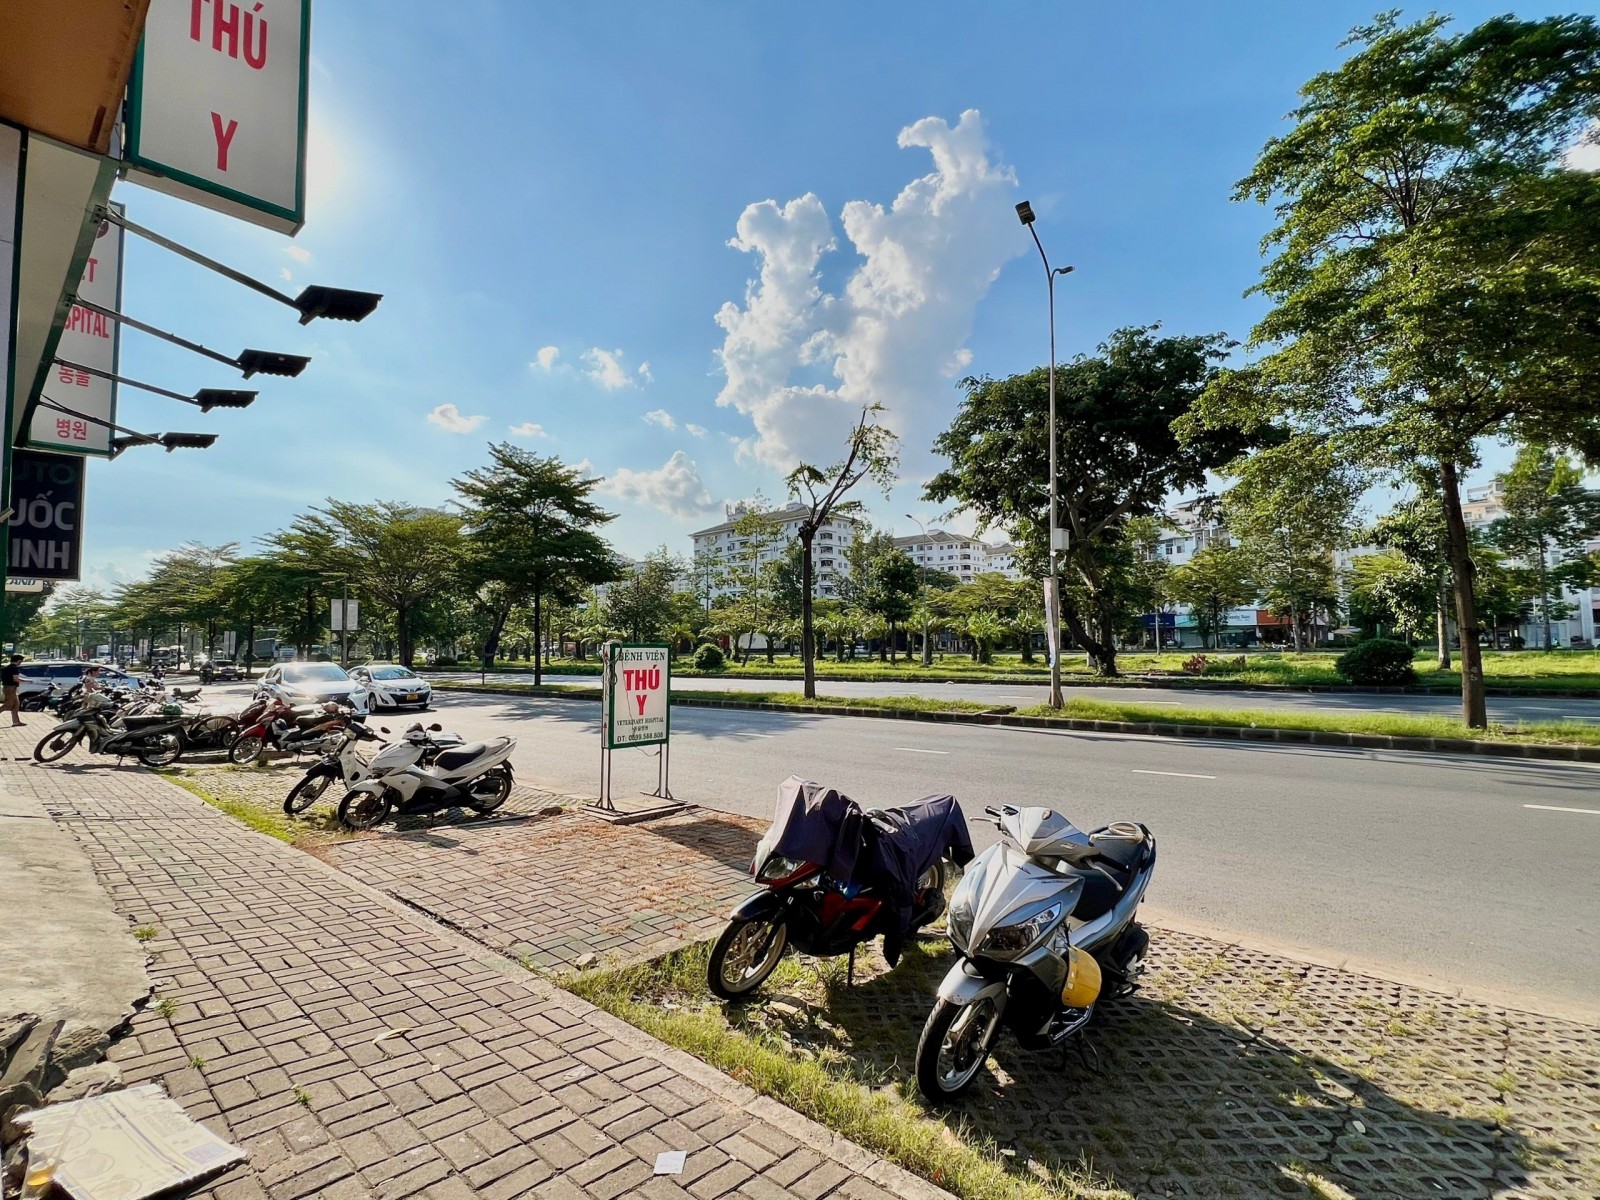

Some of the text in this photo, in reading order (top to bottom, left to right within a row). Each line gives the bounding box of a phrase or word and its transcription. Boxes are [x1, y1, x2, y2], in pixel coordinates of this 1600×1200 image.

[190, 0, 268, 70] THÚ
[210, 111, 238, 172] Y
[57, 418, 87, 441] 병원
[623, 664, 660, 691] THÚ
[636, 694, 647, 716] Y
